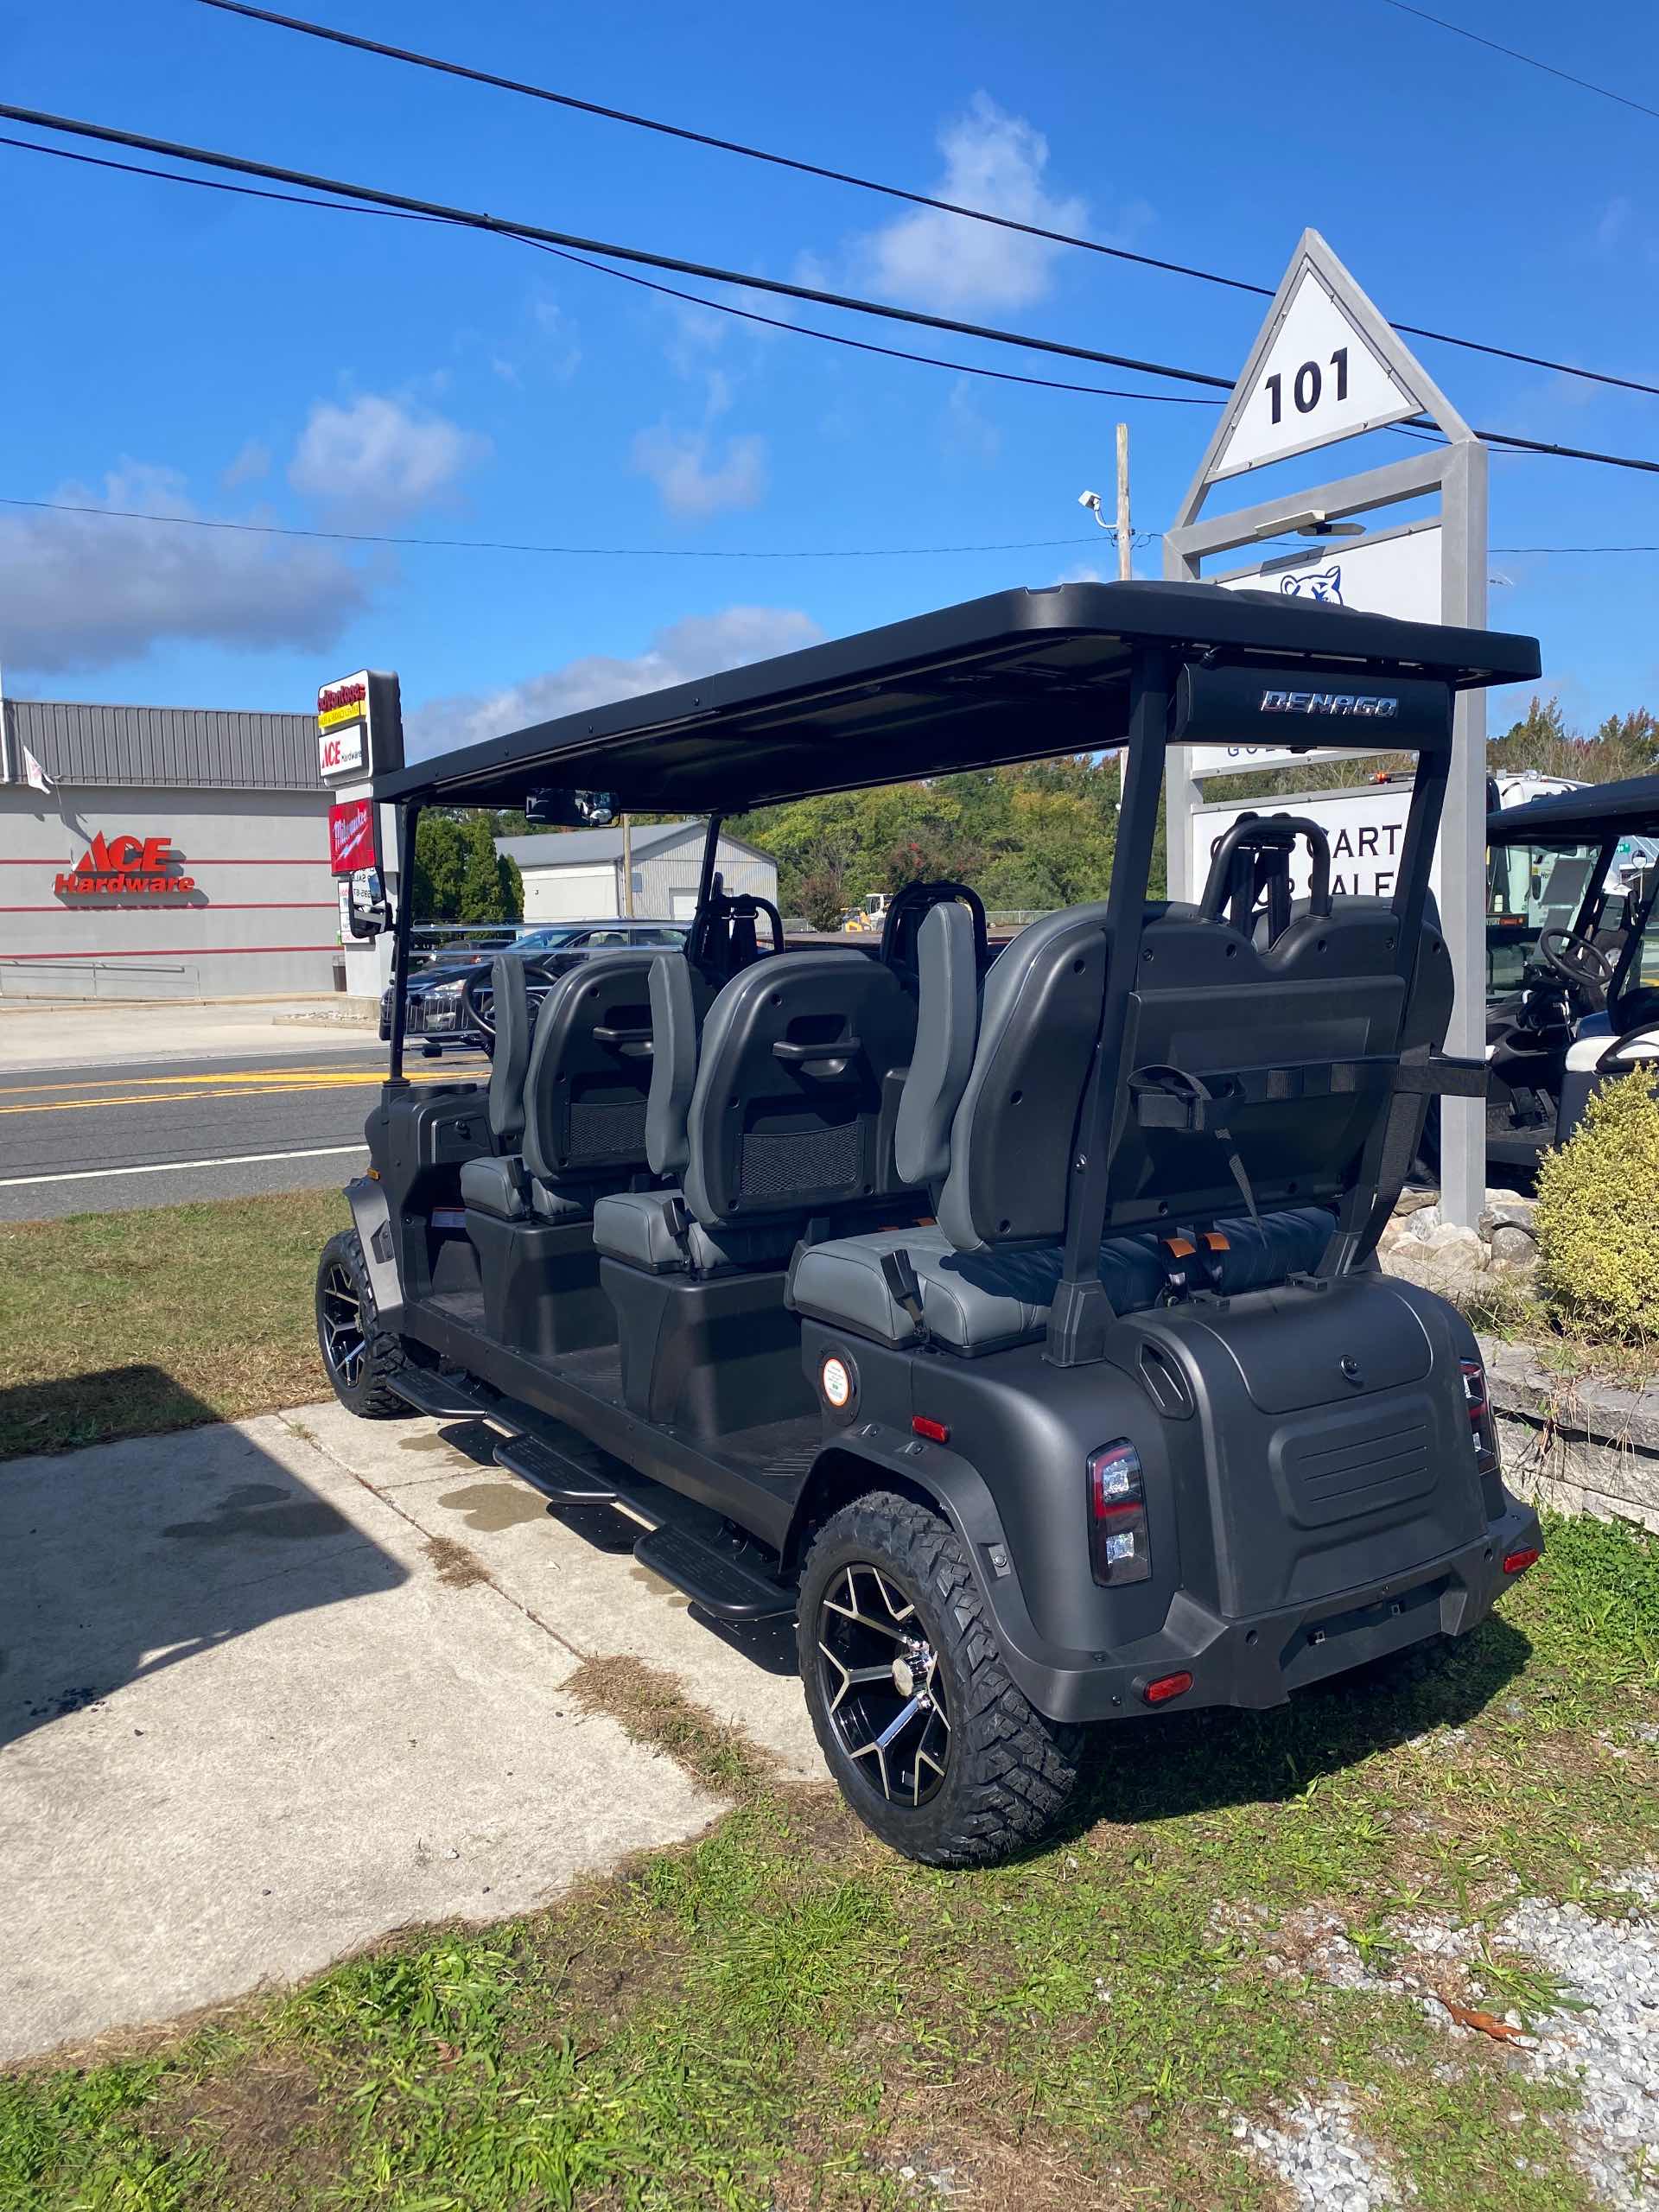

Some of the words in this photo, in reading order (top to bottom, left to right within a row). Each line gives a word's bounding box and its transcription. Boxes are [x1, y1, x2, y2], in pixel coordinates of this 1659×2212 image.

[1265, 346, 1348, 424] 101
[1259, 690, 1399, 718] DENAGO
[321, 741, 340, 768] ACE
[73, 830, 172, 873] ACE
[54, 873, 195, 894] Hardware
